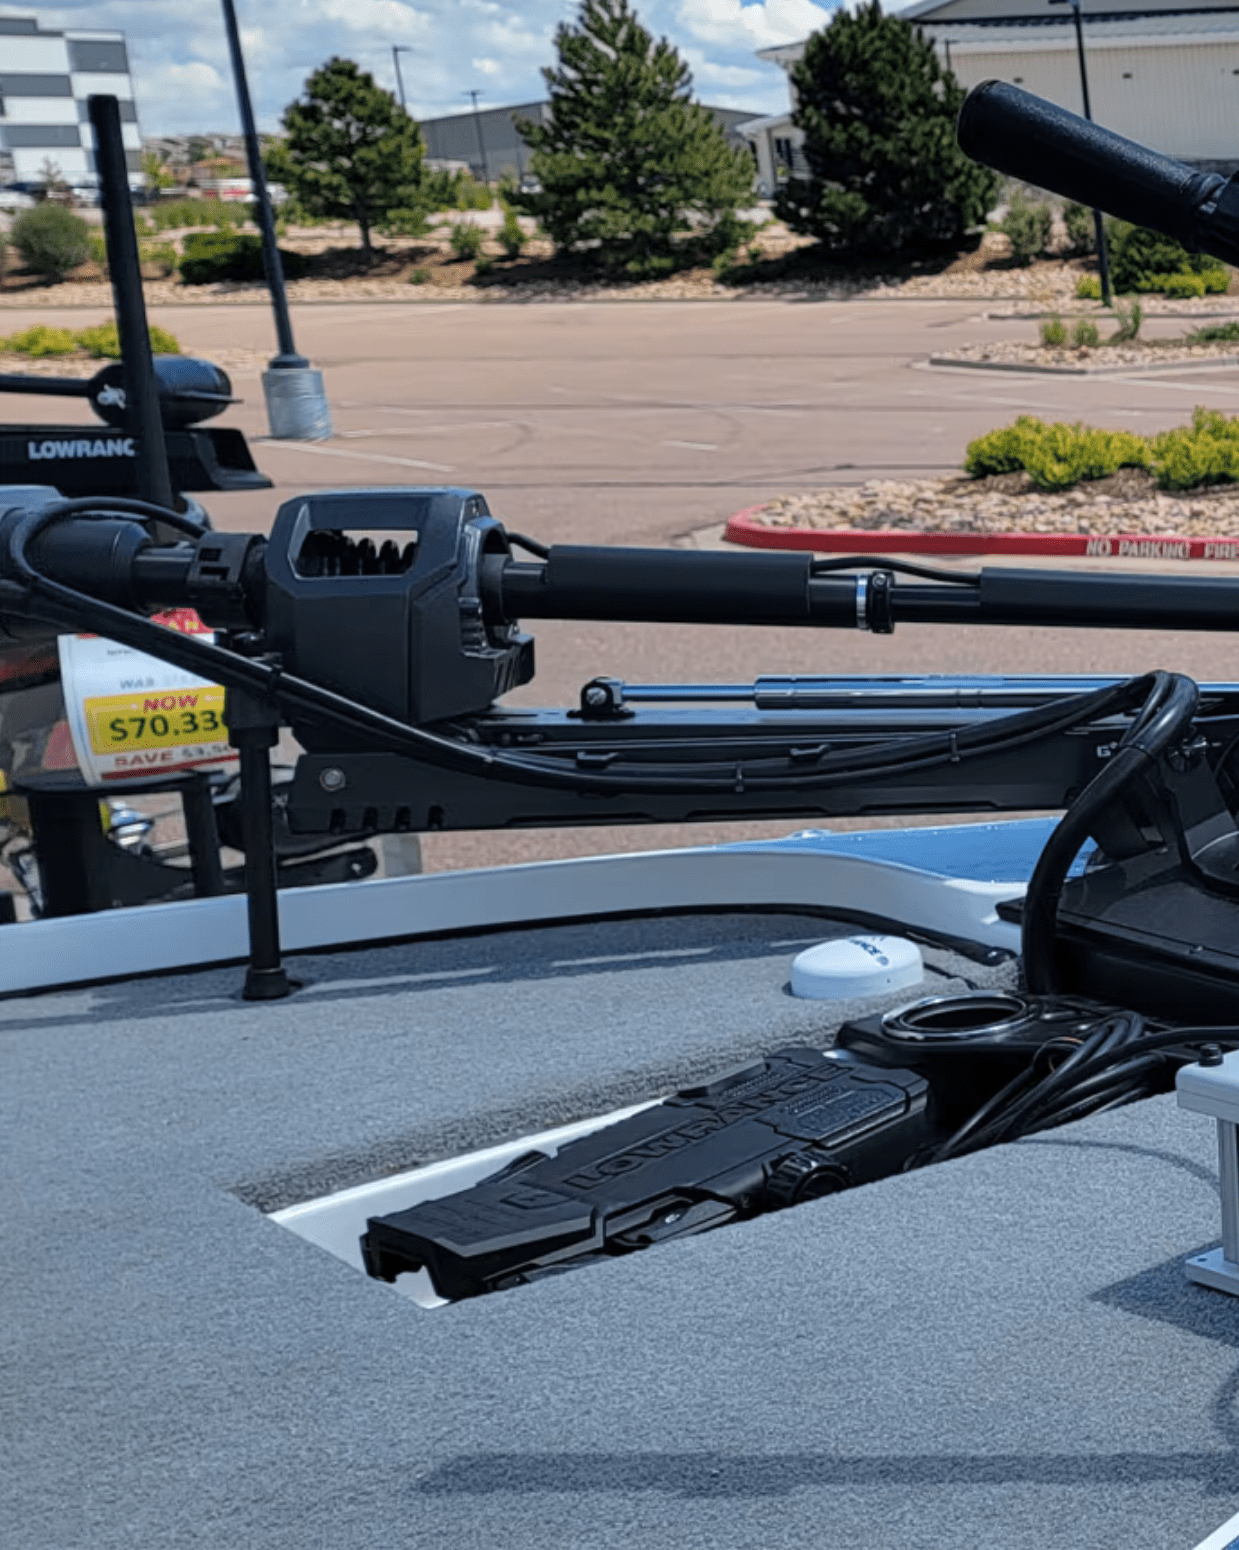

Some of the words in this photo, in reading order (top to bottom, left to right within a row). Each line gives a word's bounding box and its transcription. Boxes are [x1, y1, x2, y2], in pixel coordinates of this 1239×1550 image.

[28, 438, 136, 460] LOWRANC
[1087, 538, 1112, 557] NO
[1119, 540, 1190, 559] PARKING
[143, 694, 198, 713] NOW
[114, 751, 173, 767] SAVE
[562, 1062, 853, 1191] LOWRANCE
